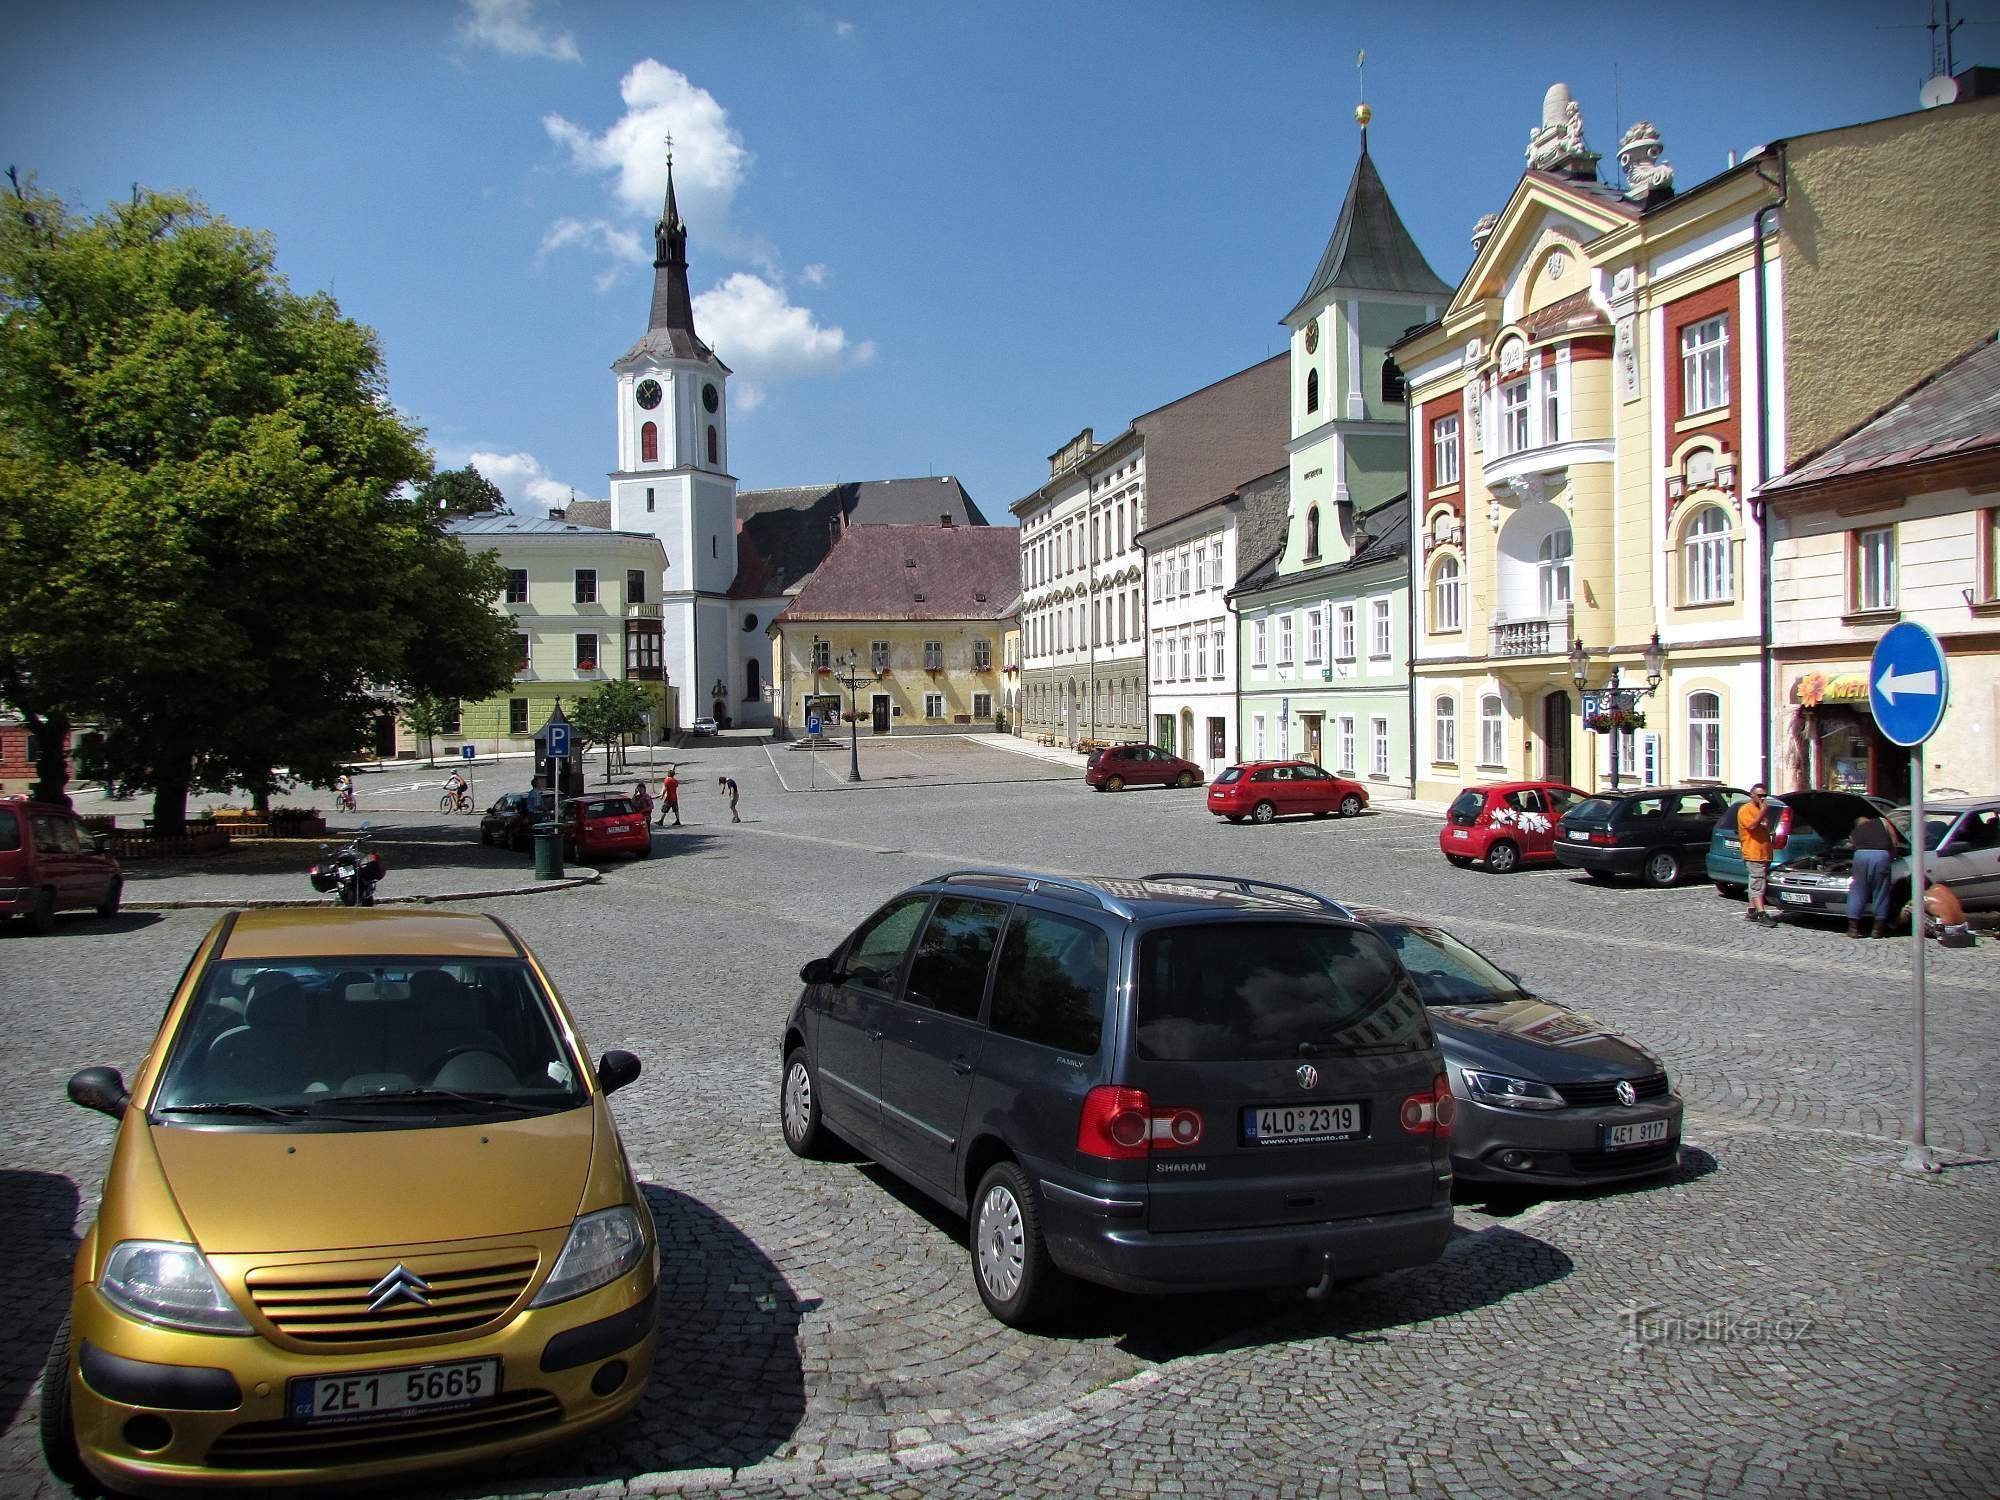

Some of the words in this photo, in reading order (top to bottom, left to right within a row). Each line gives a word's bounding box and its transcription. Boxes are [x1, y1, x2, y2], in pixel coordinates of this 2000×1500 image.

[1585, 699, 1596, 719] P
[810, 718, 818, 729] P
[551, 727, 565, 747] P
[1056, 1056, 1083, 1069] FAMILY
[1247, 1127, 1256, 1136] CZ
[1309, 1107, 1352, 1131] 2319
[1613, 1126, 1633, 1144] 4E1
[1640, 1122, 1664, 1140] 9117
[1156, 1162, 1206, 1173] SHARAN
[296, 1403, 312, 1414] CZ
[321, 1378, 379, 1412] 2E1
[407, 1365, 483, 1402] 5665
